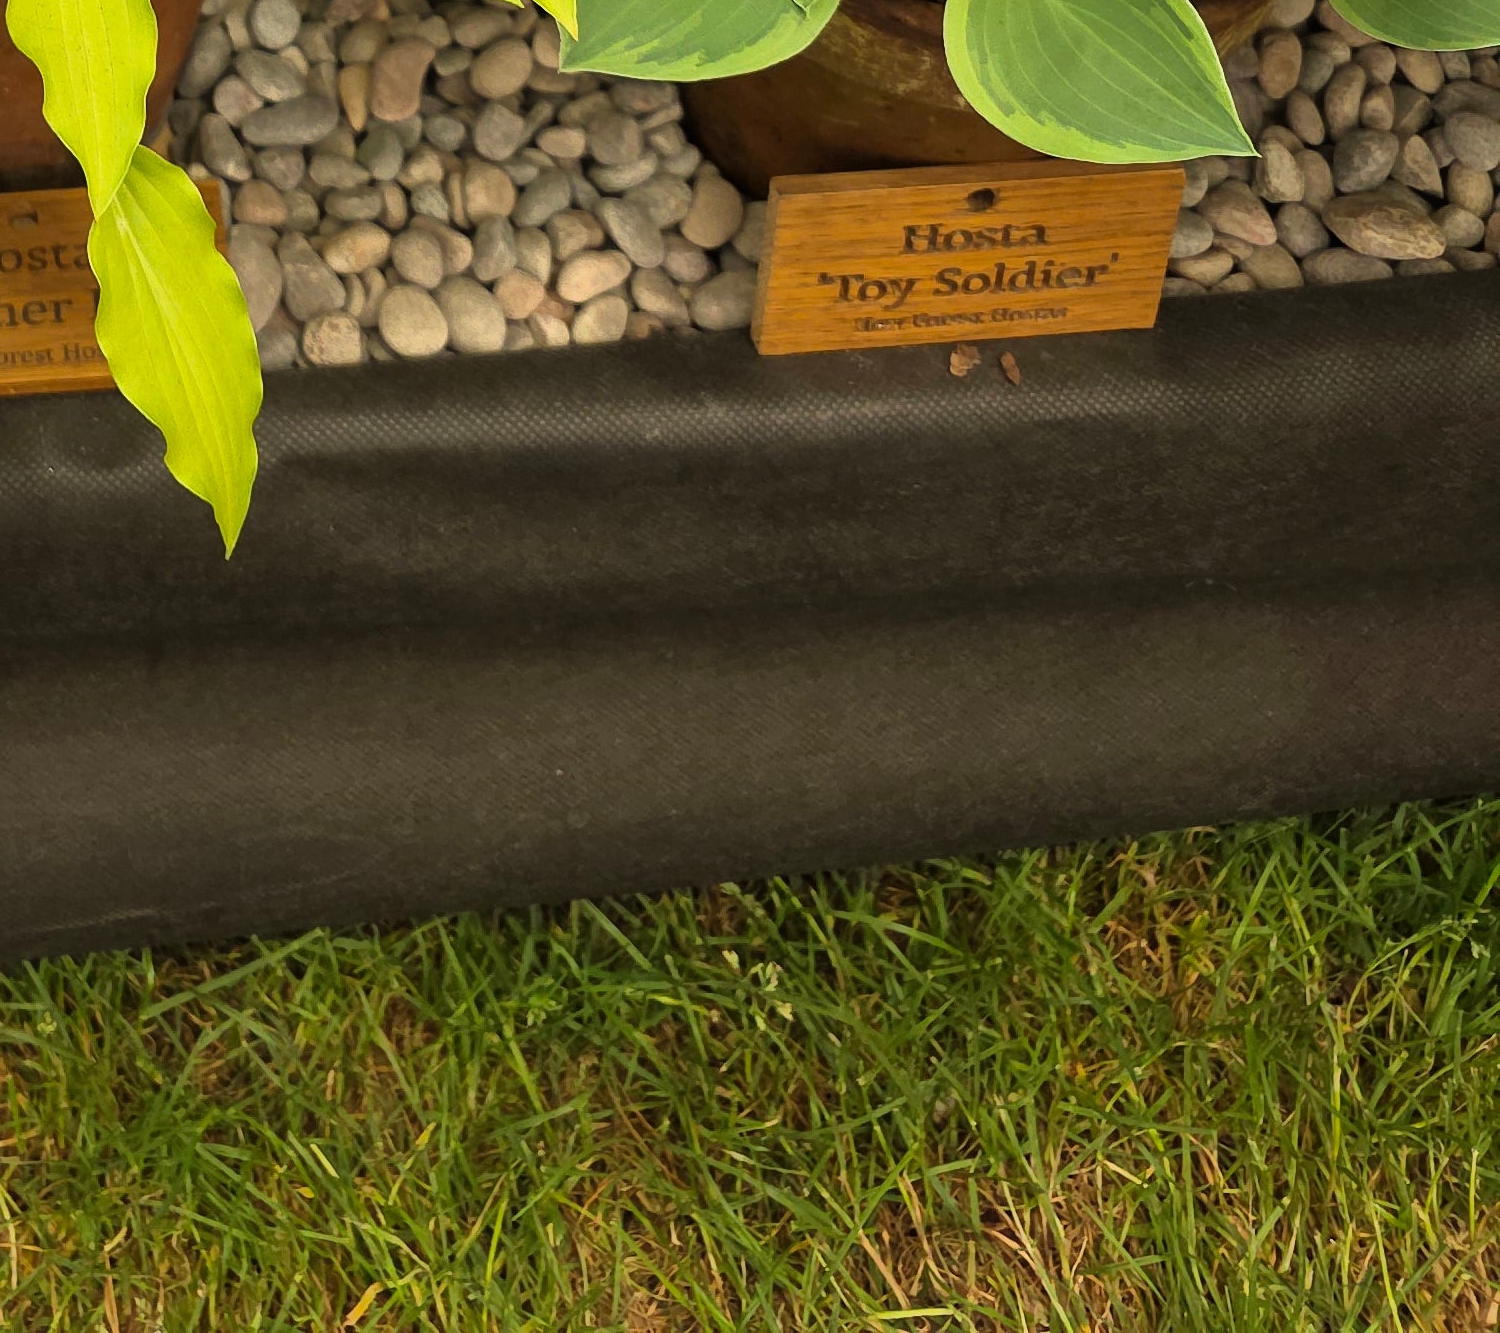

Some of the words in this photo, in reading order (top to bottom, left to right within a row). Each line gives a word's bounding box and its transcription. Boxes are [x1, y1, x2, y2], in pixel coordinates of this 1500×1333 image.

[902, 222, 1049, 254] Hosta
[817, 271, 921, 311] 'Toy
[931, 252, 1120, 296] Soldier'
